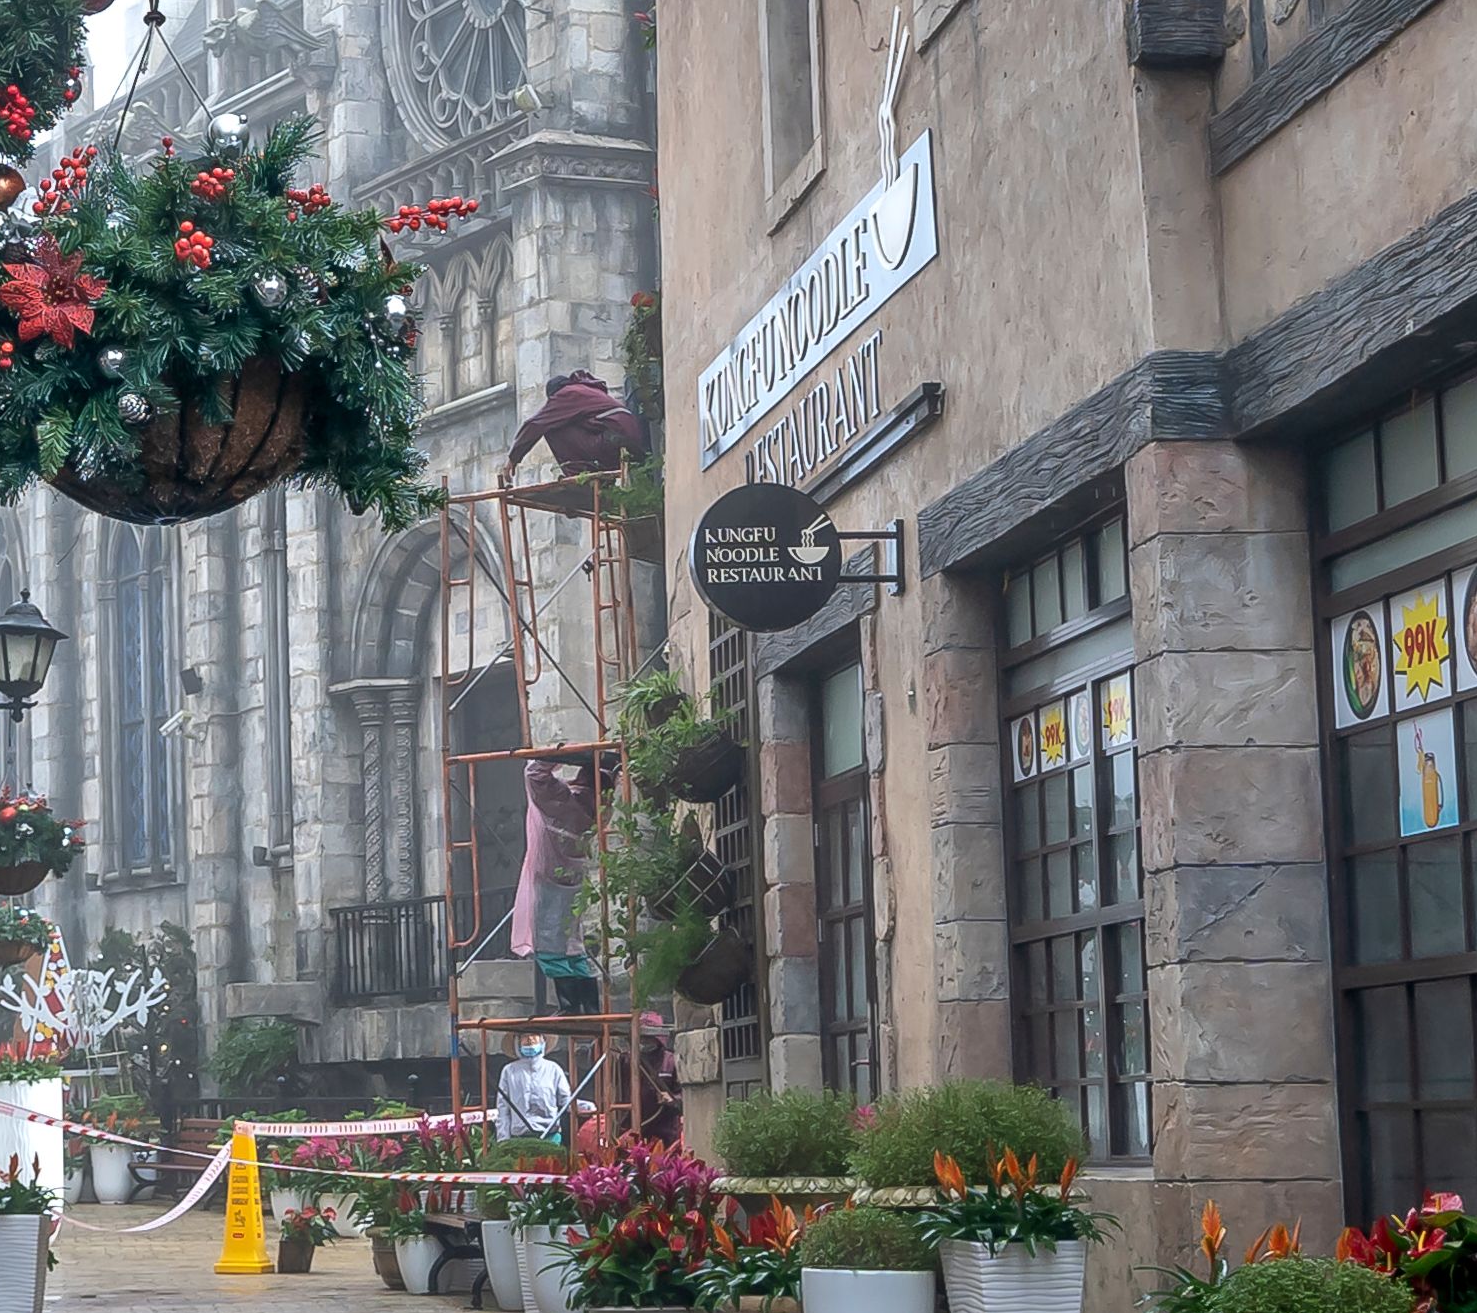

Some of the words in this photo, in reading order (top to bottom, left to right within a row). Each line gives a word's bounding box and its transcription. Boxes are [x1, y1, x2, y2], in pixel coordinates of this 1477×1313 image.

[702, 315, 776, 453] KUNGFU
[776, 218, 870, 382] NOODLE
[705, 527, 776, 544] KUNGFU
[706, 546, 780, 563] NOODLE
[707, 566, 823, 583] RESTAURANT
[1404, 619, 1439, 668] 99K
[1046, 721, 1062, 747] 99K
